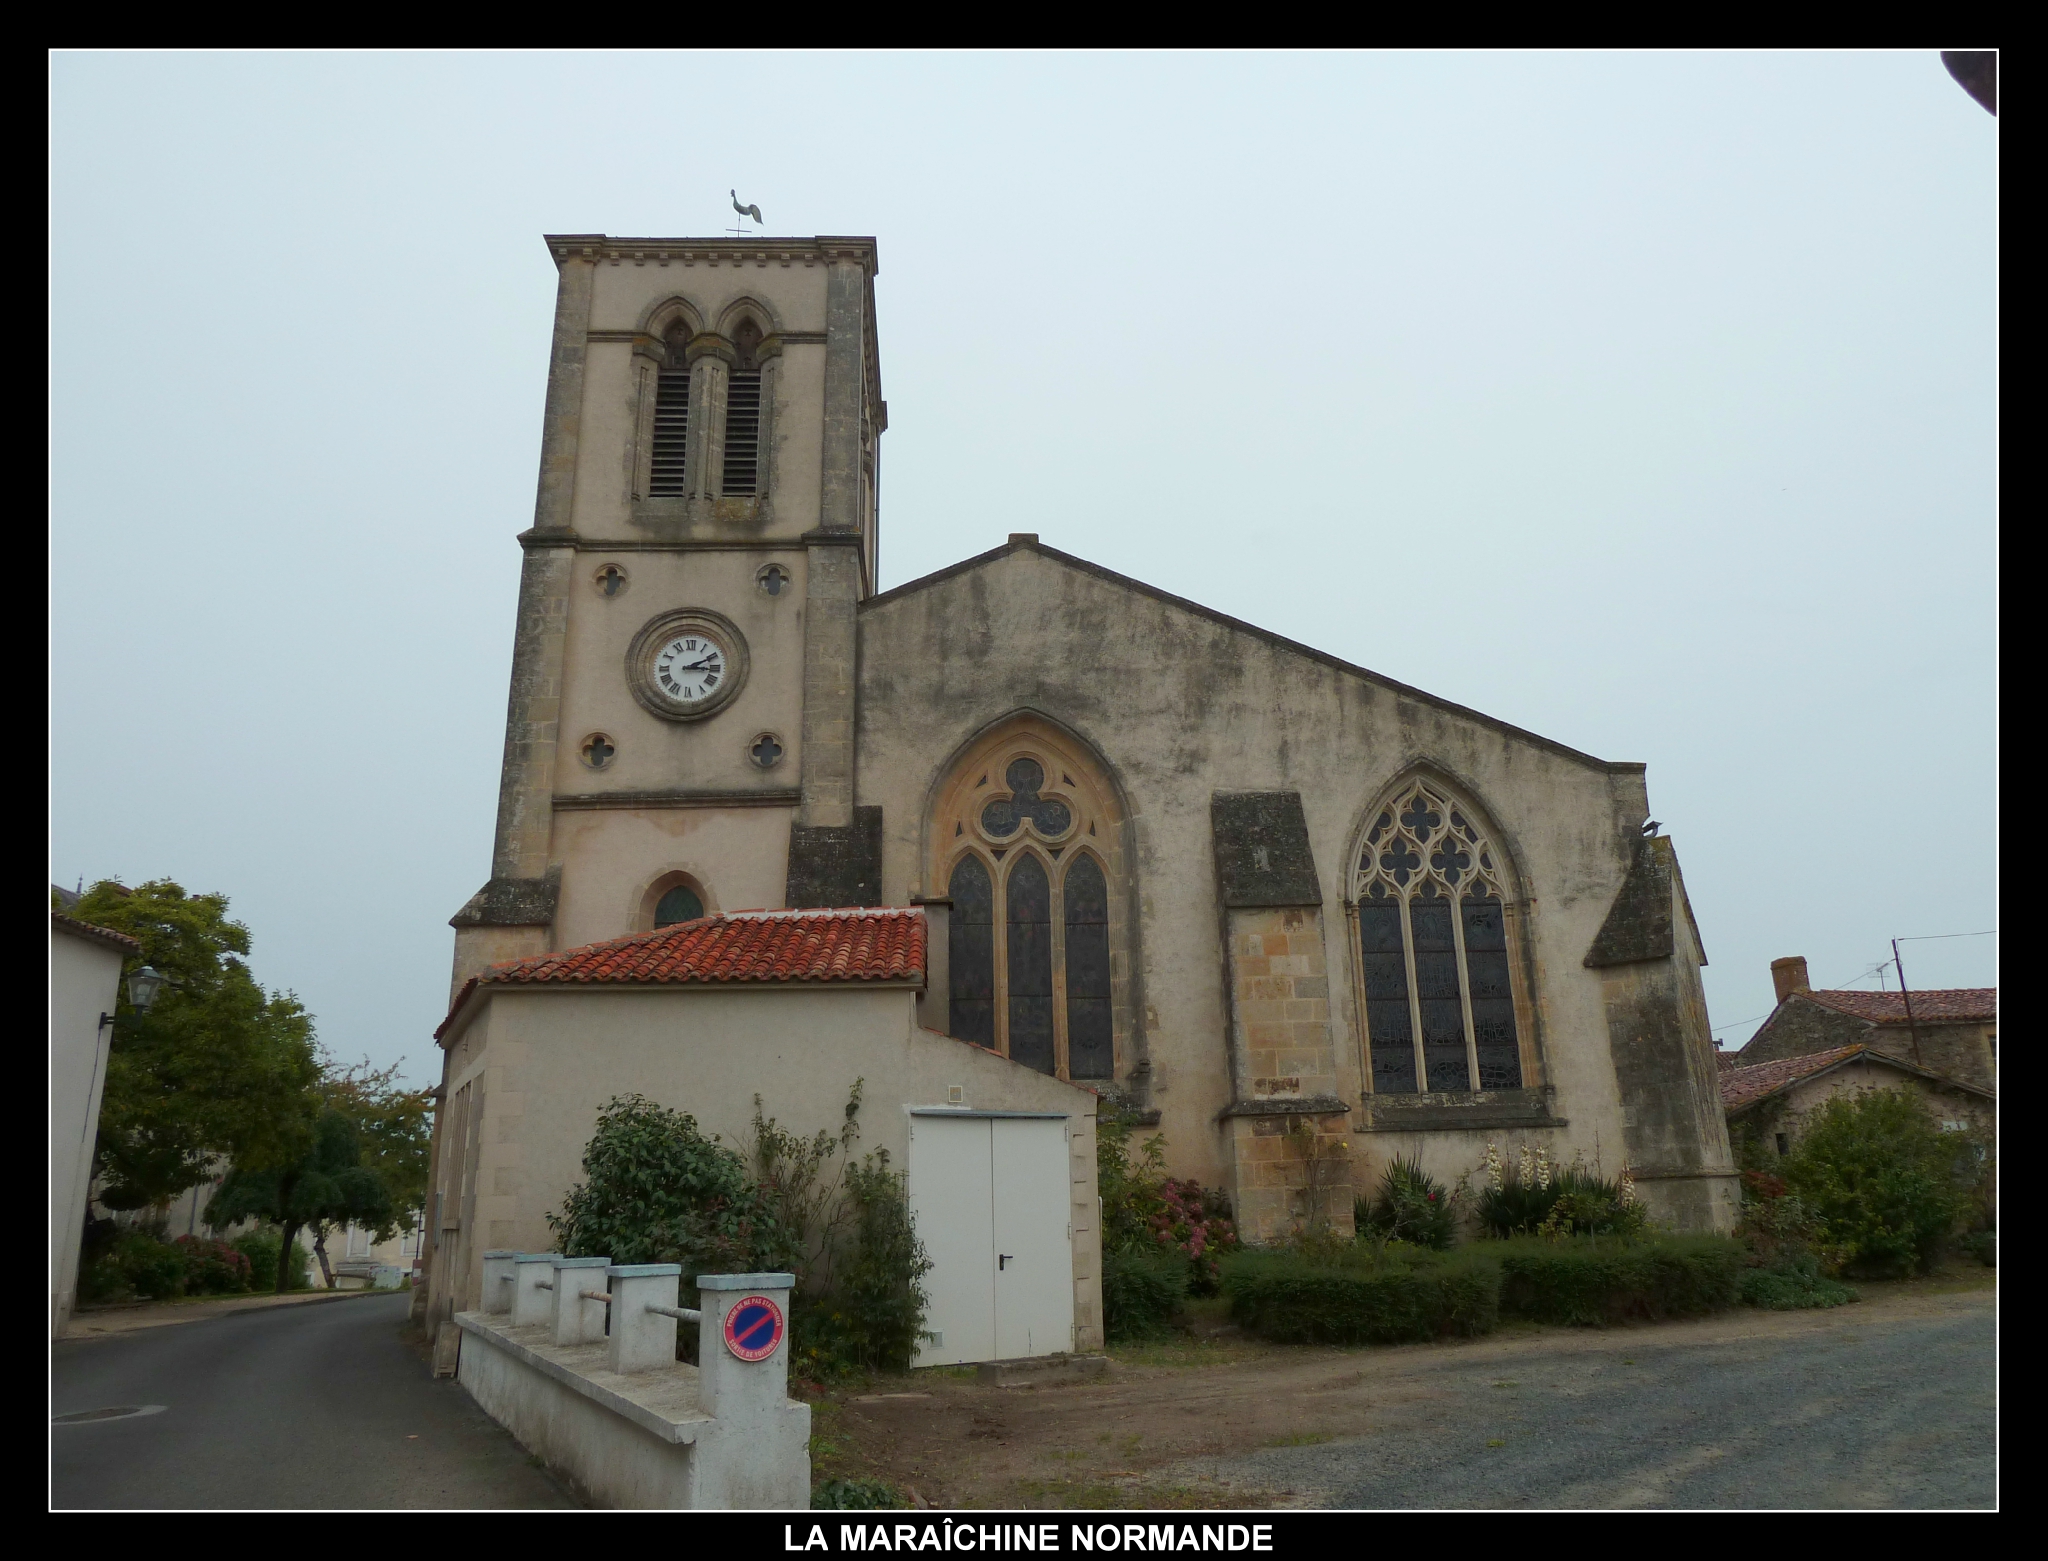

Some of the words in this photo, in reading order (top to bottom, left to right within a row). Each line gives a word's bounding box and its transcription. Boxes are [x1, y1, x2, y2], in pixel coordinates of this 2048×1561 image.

[686, 640, 696, 651] XII
[700, 644, 708, 652] I
[663, 652, 674, 661] X
[699, 685, 706, 694] V
[729, 1339, 744, 1355] SORTIE
[755, 1339, 777, 1357] VOITURES
